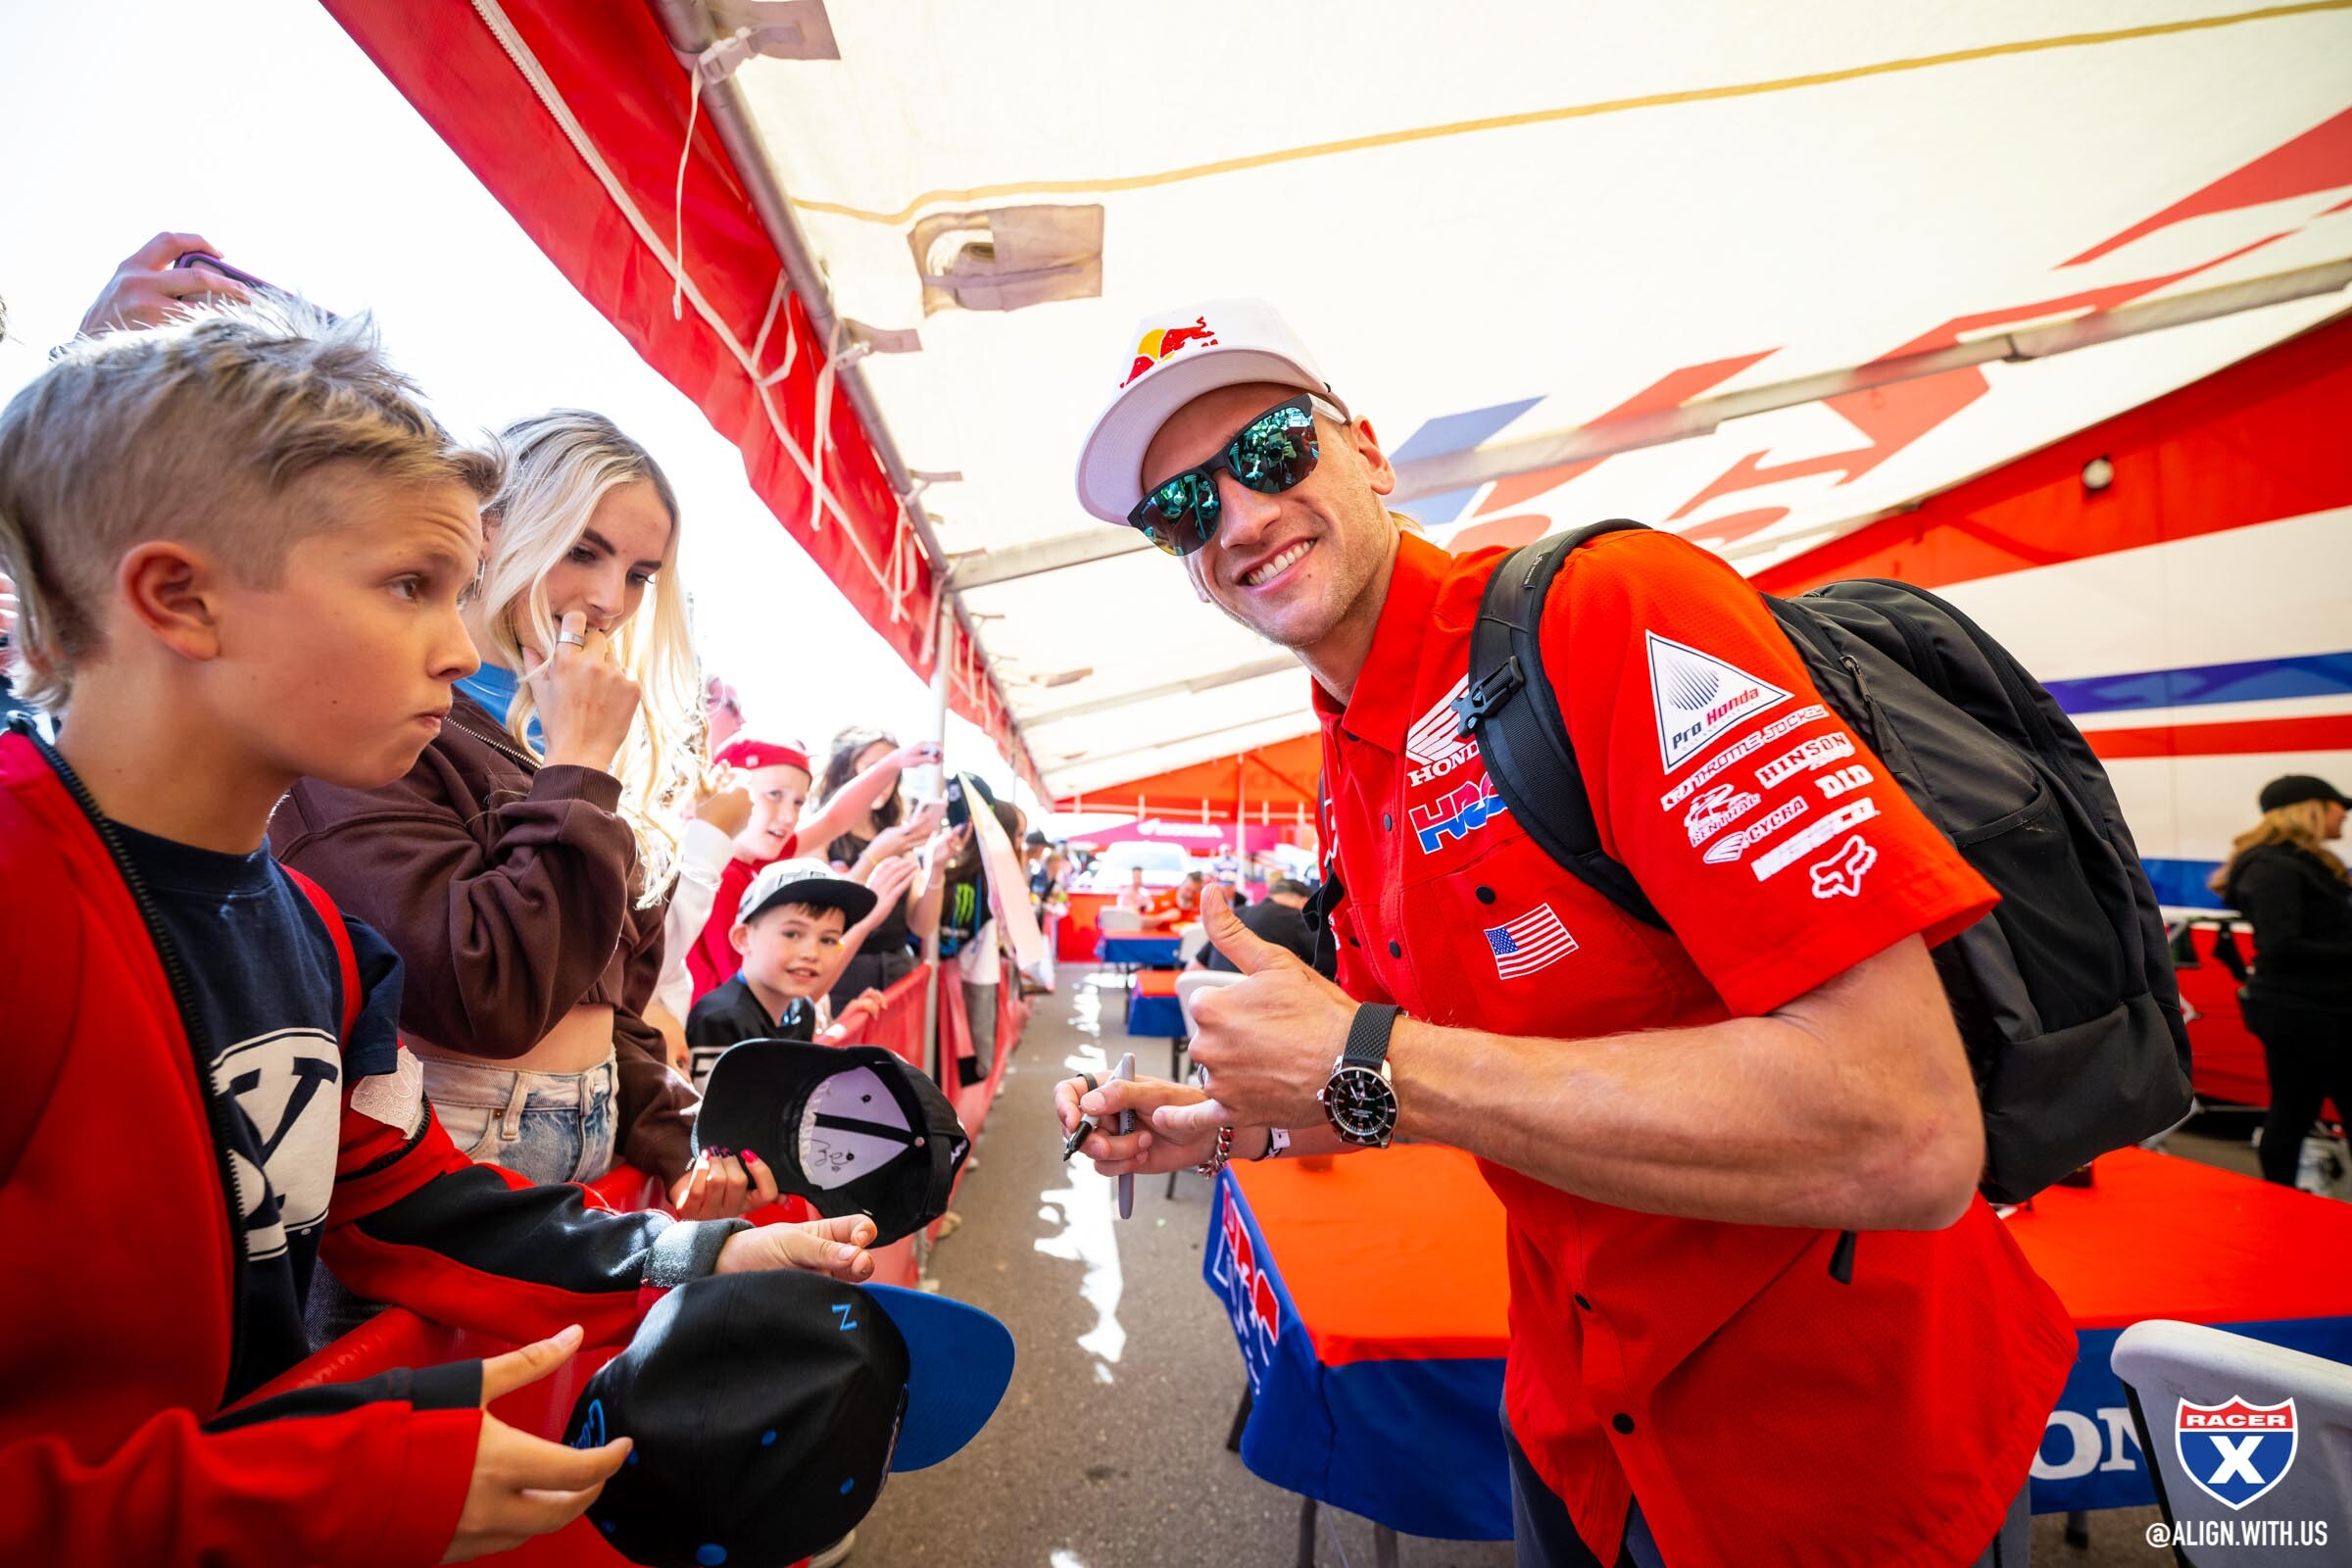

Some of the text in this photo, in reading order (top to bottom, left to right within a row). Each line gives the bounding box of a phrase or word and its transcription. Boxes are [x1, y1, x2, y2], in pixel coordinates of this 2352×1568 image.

[1672, 721, 1702, 750] Pro
[1706, 688, 1759, 726] Honda
[1407, 740, 1480, 787] HOND
[1760, 734, 1847, 782] HINSON
[1814, 764, 1874, 800] DID
[1747, 799, 1804, 842] CYCRA
